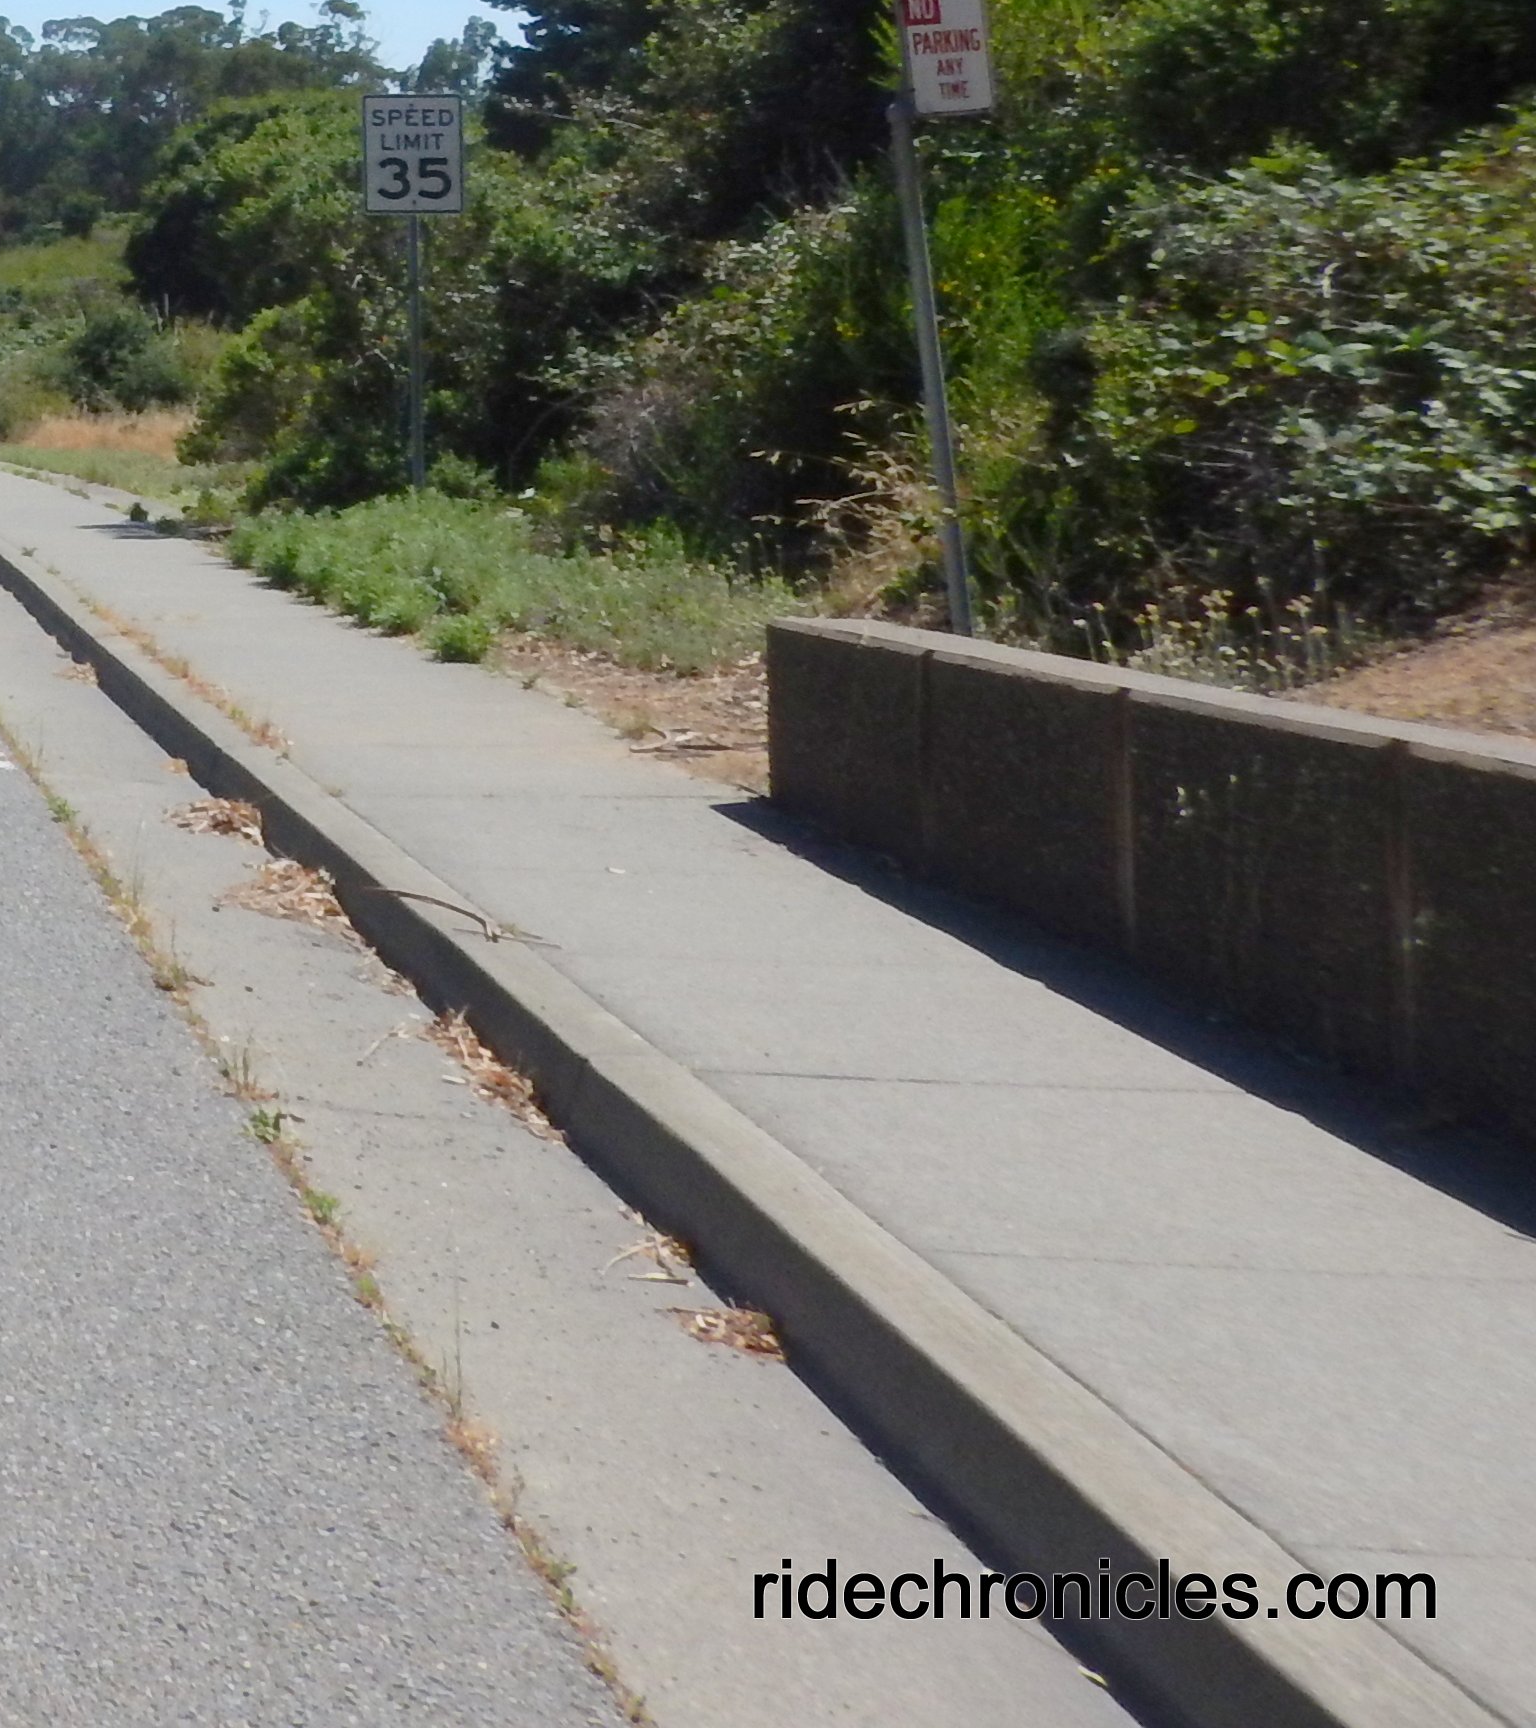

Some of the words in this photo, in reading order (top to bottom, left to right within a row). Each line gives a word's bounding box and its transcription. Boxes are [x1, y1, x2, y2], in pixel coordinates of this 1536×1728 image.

[912, 28, 981, 55] PARKING
[937, 57, 963, 76] ANY
[938, 80, 970, 100] TIME
[371, 109, 454, 127] SPEED
[381, 133, 445, 151] LIMIT
[378, 157, 452, 200] 35
